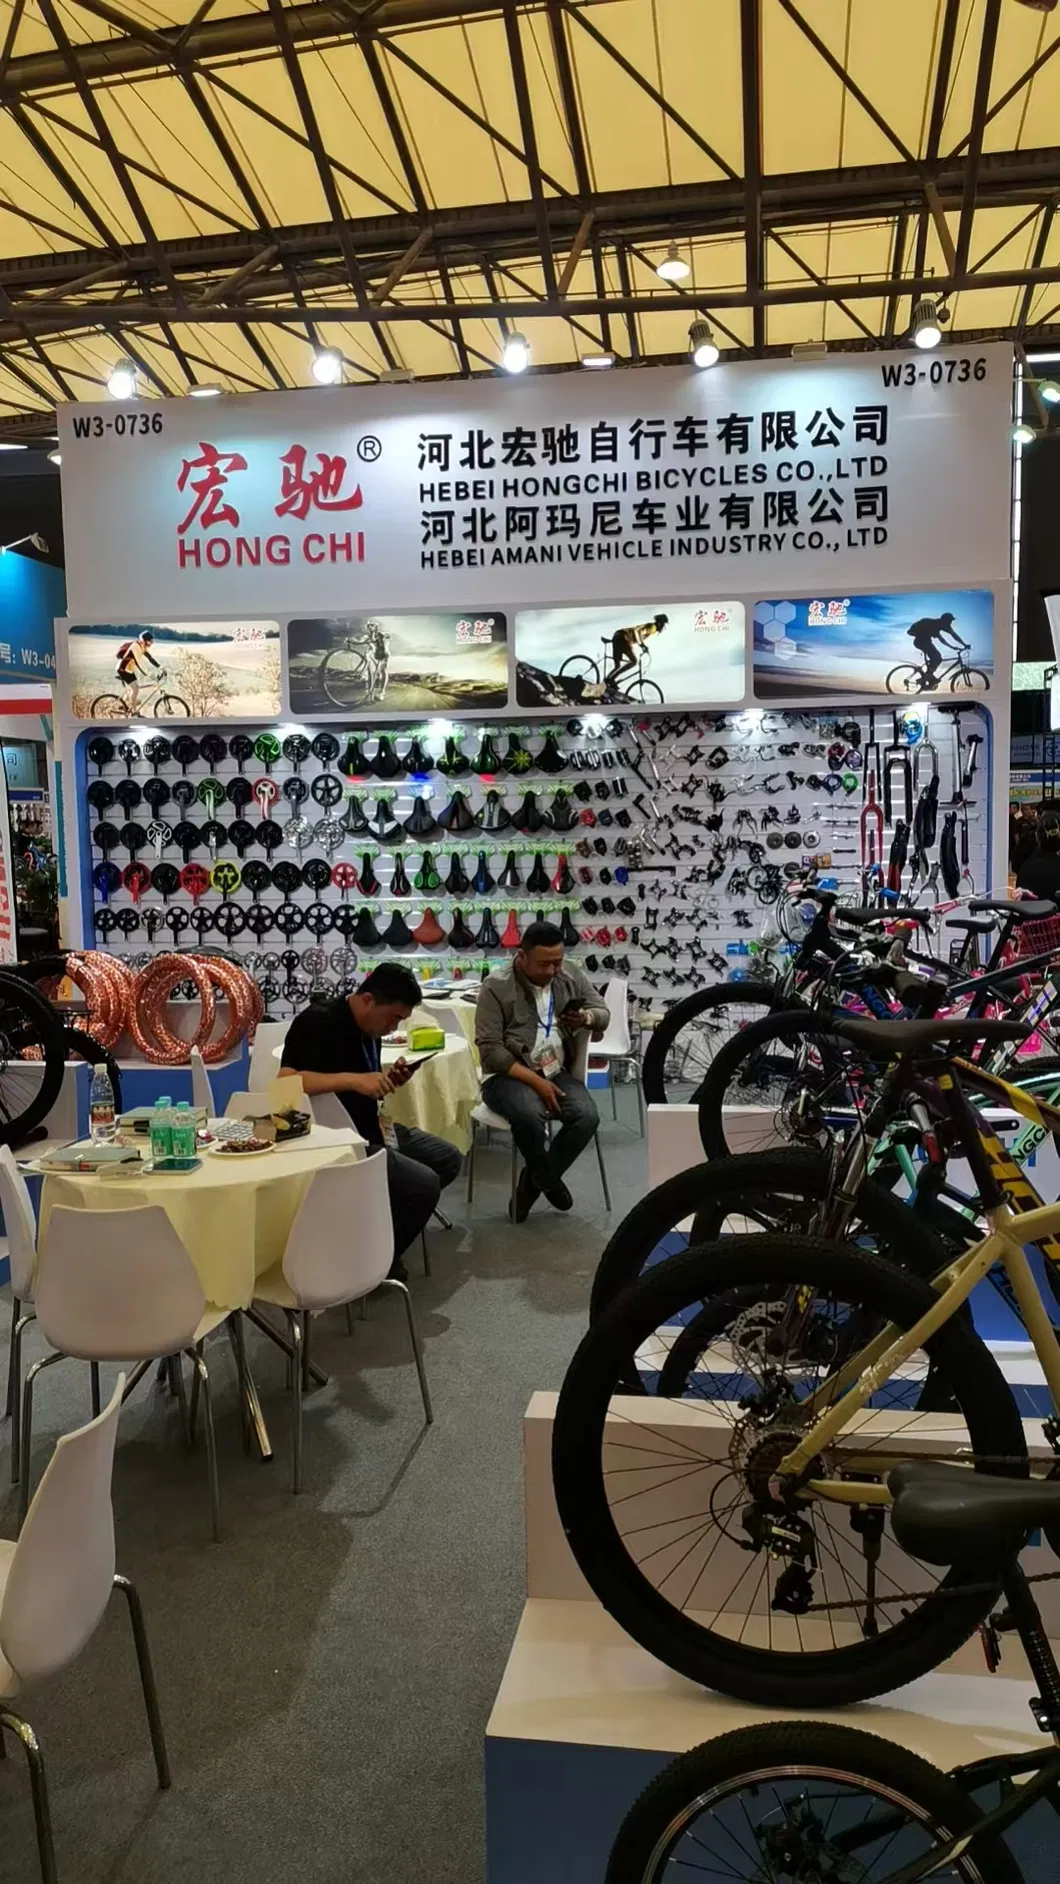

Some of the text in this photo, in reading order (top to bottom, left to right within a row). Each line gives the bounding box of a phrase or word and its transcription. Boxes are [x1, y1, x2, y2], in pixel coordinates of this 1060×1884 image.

[882, 357, 987, 388] W3-0736
[73, 412, 163, 438] W3-0736
[417, 405, 888, 472] 河北宏驰自行车有限公司
[176, 441, 363, 535] 宏驰
[419, 479, 494, 503] HEBEI
[503, 471, 627, 498] HONGCHI
[636, 463, 767, 491] BICYCLES
[421, 485, 888, 545] 河北阿玛尼车业有限公司
[177, 531, 364, 569] HONG CHI
[421, 548, 484, 569] HEBEI
[491, 544, 562, 566] AMANI
[567, 538, 662, 561] VEHICLE
[670, 532, 786, 556] INDUSTRY
